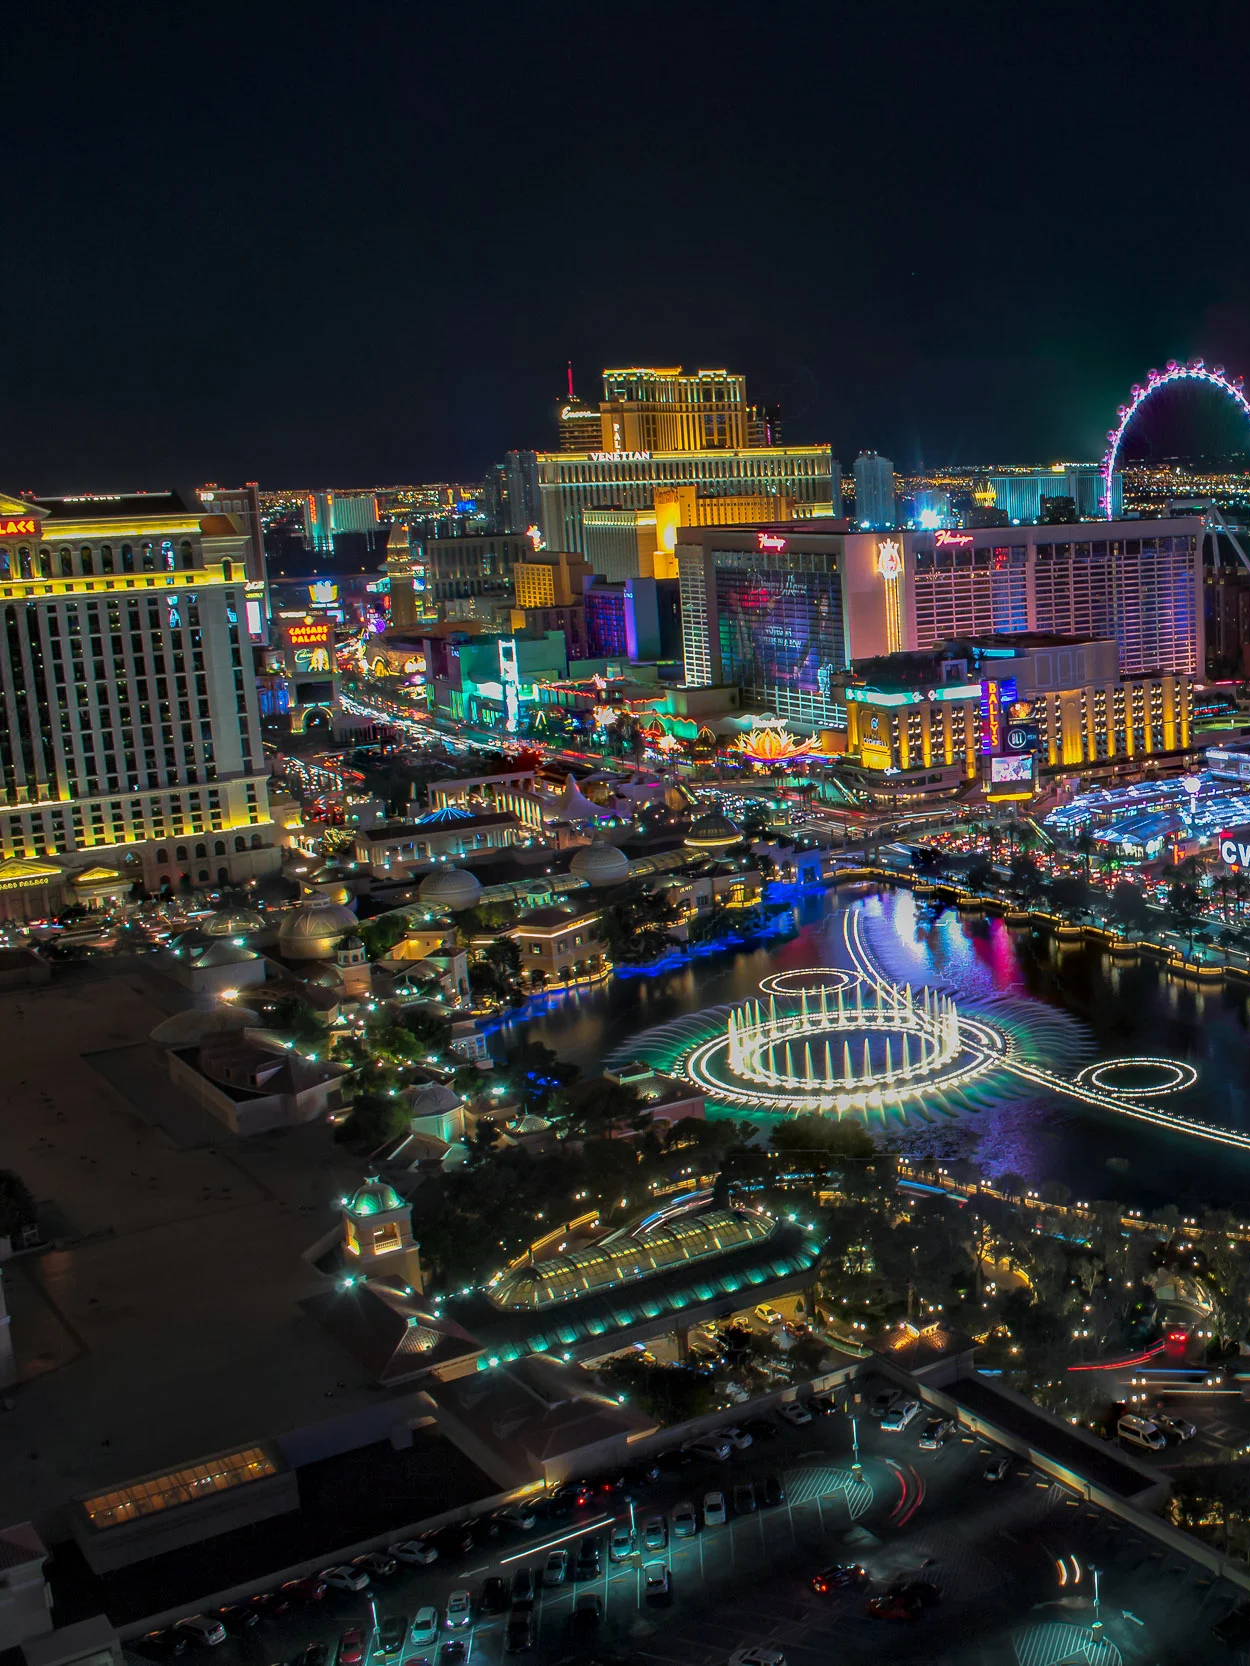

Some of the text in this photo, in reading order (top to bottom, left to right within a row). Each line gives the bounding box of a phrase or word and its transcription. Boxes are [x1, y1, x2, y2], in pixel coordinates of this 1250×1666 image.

[613, 423, 621, 453] PAL
[590, 452, 650, 461] VENETIAN
[289, 625, 328, 635] CAESARS
[291, 633, 327, 643] PALACE
